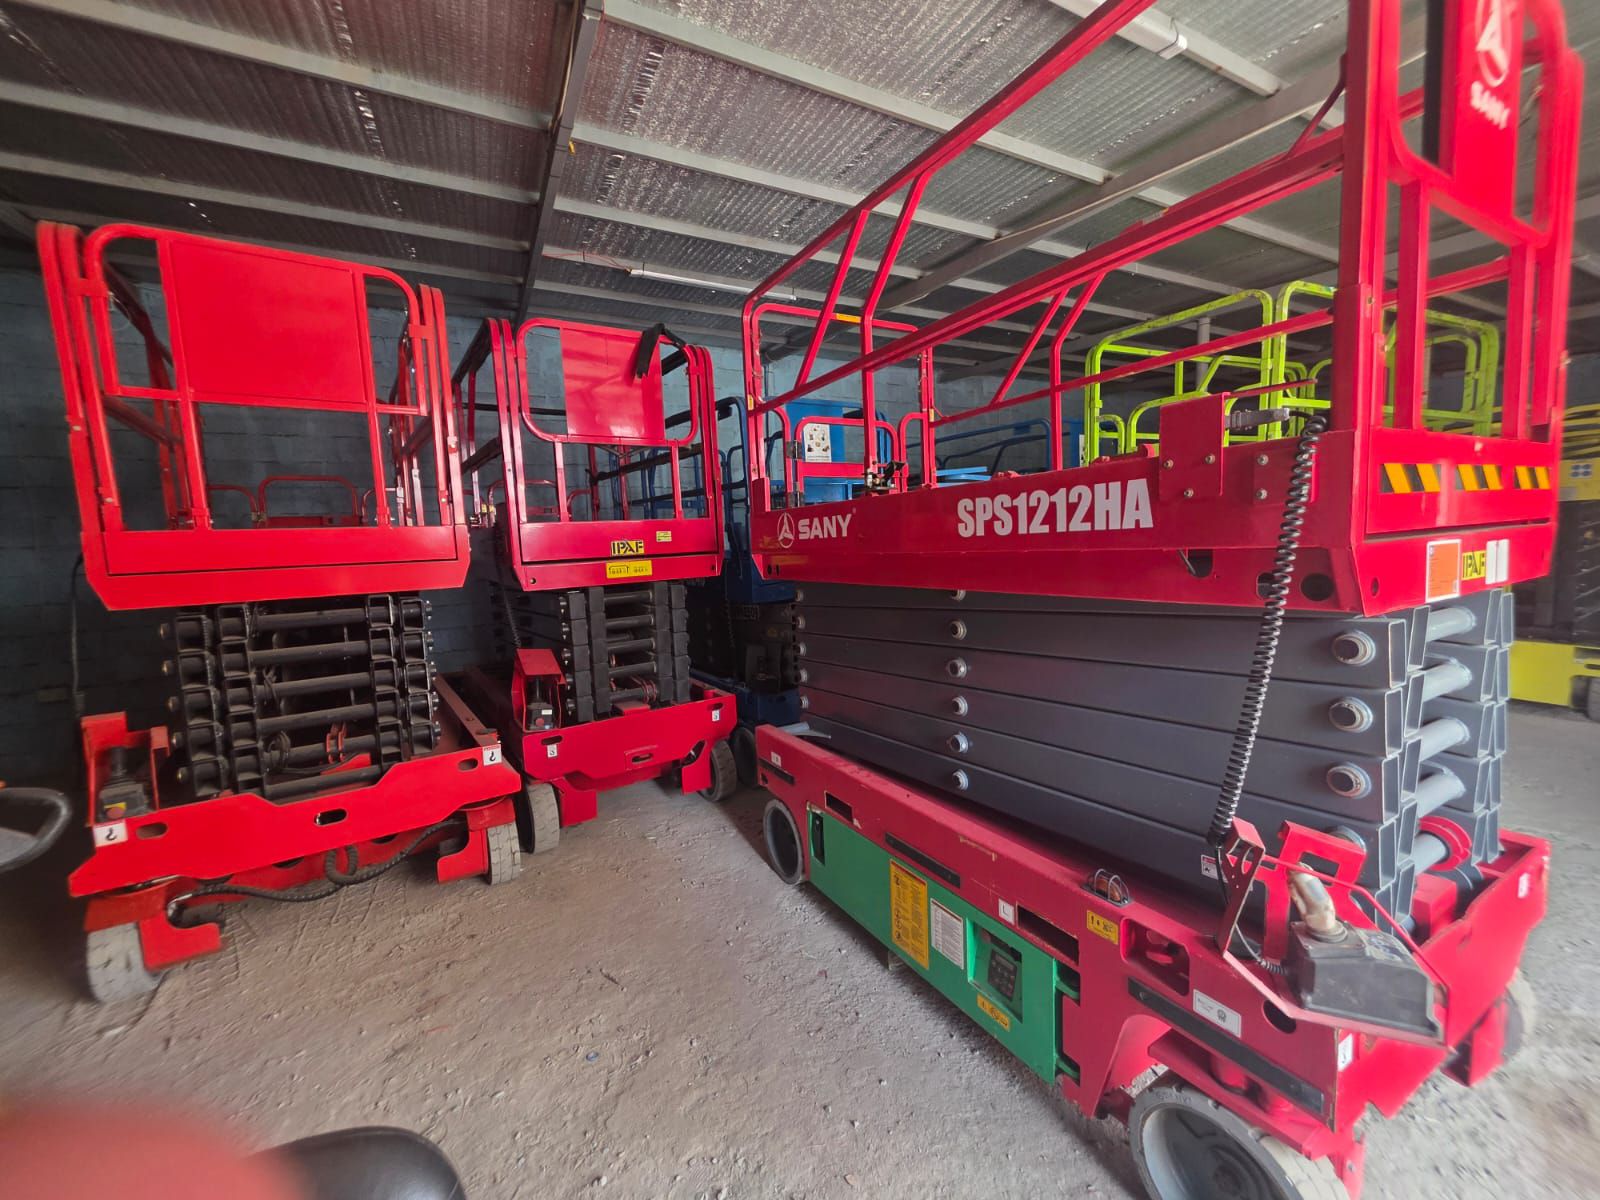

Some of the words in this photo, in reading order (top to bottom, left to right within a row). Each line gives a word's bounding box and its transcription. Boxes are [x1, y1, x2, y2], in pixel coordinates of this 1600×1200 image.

[957, 478, 1154, 538] SPS1212HA
[797, 513, 852, 540] SANY
[612, 541, 644, 555] IPAF
[1462, 551, 1486, 579] IPAF
